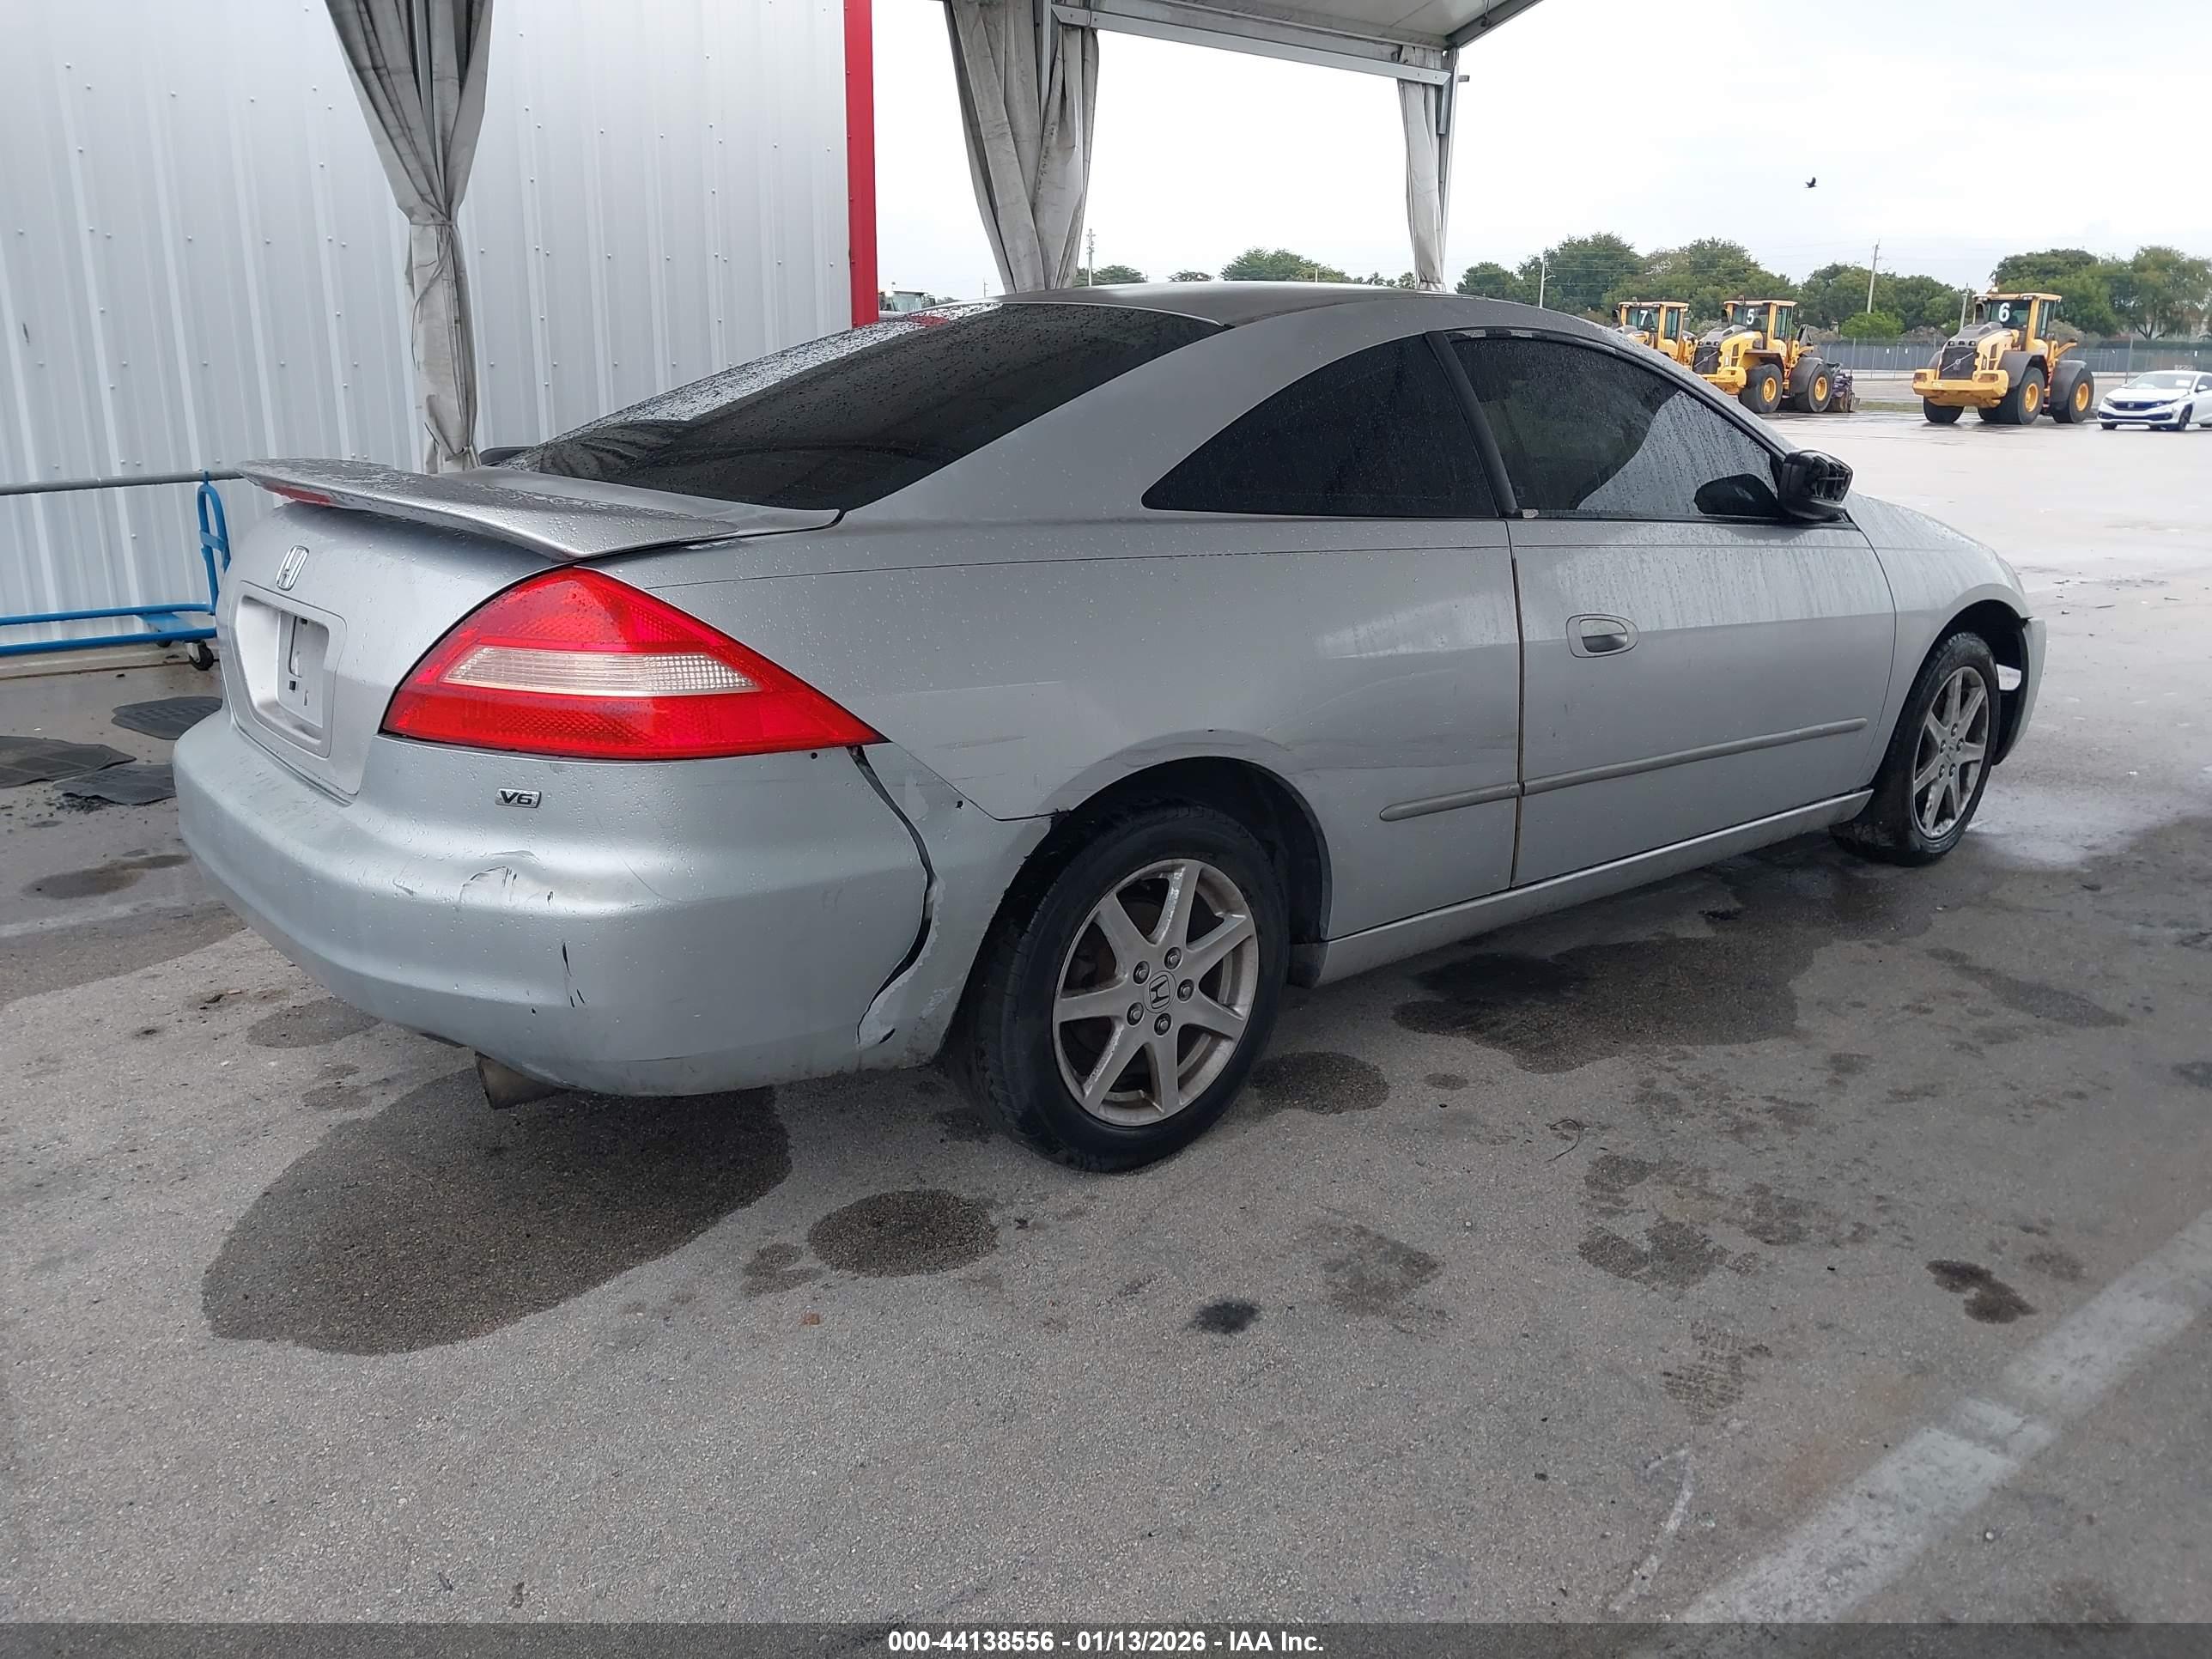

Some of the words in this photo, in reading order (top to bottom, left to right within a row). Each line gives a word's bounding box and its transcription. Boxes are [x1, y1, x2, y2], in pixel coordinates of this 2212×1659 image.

[1639, 309, 1649, 326] 7
[1746, 308, 1755, 325] 5
[1998, 302, 2011, 322] 6
[500, 789, 533, 805] V6
